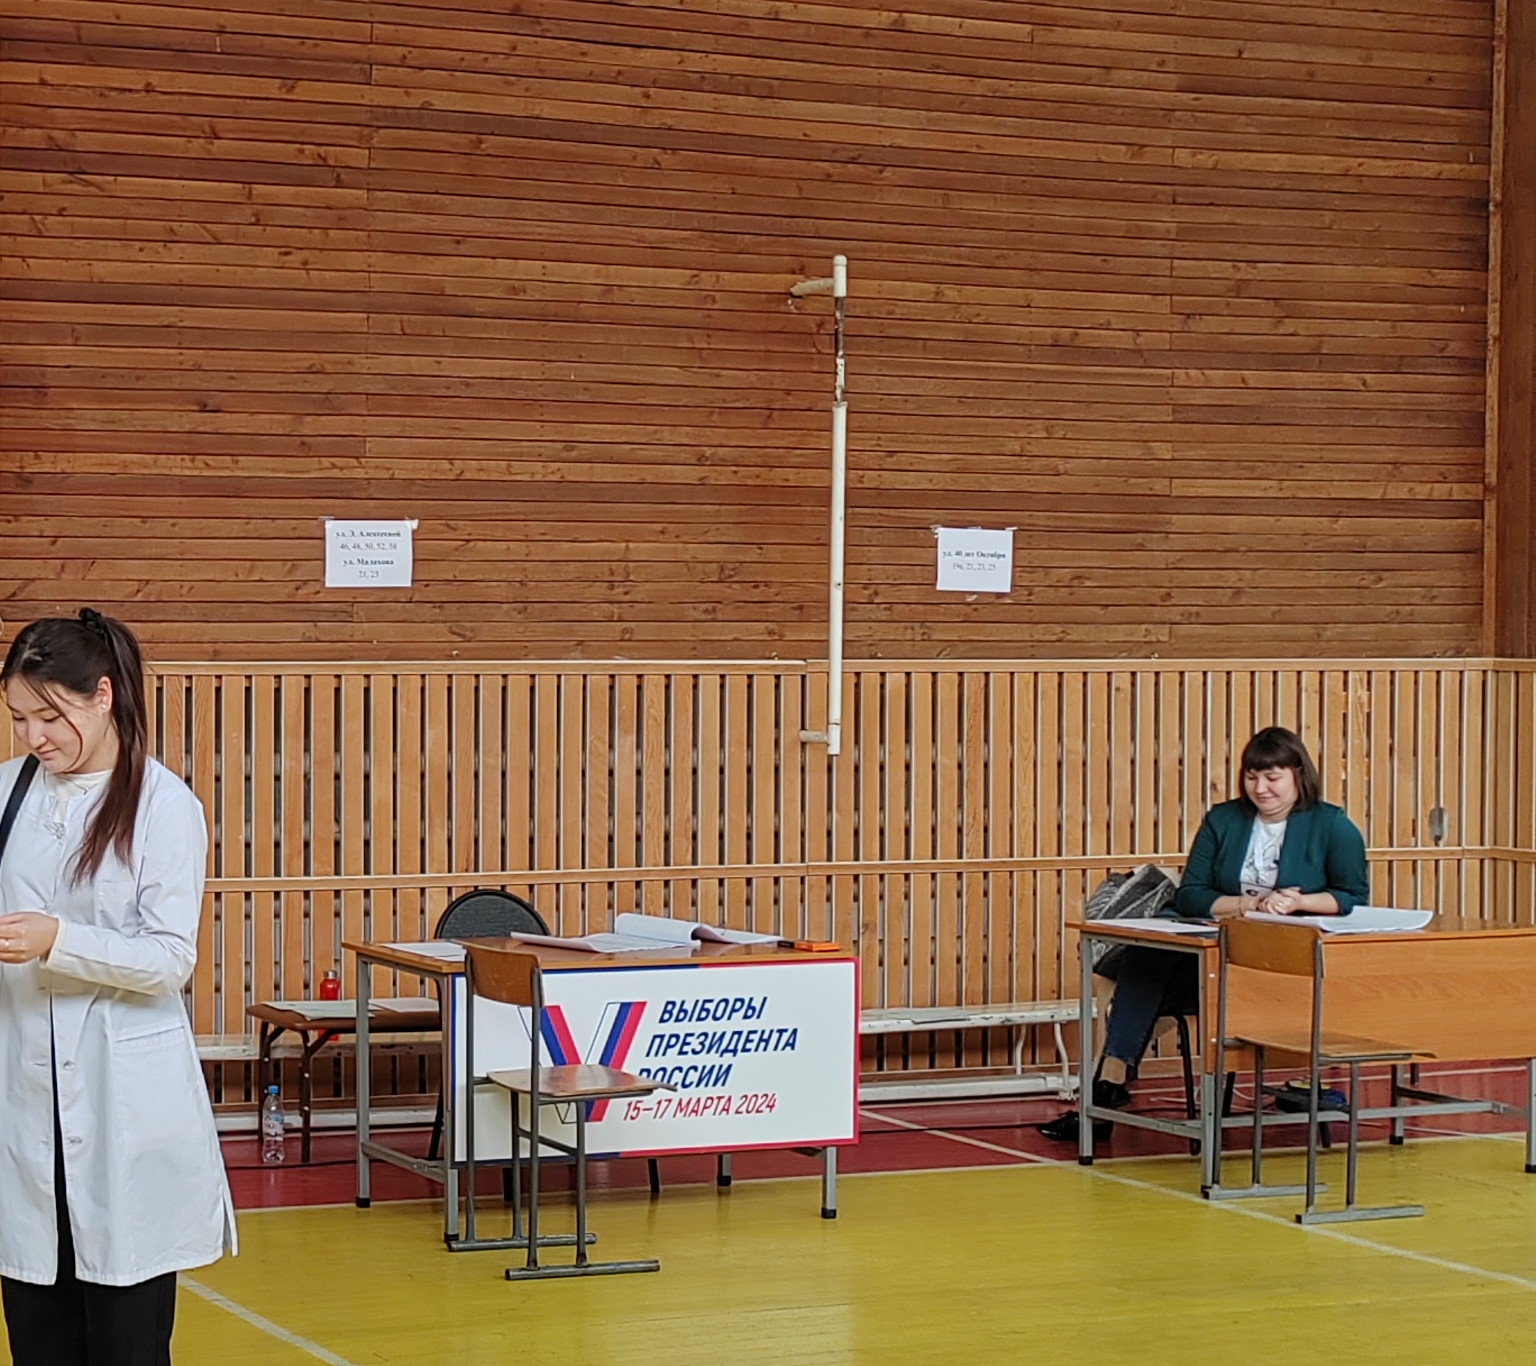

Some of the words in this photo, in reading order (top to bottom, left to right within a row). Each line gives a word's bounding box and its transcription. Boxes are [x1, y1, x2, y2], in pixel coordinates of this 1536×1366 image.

[658, 996, 768, 1024] ВЫБОРЫ
[645, 1028, 799, 1058] ПРЕЗИДЕНТА
[673, 1095, 732, 1118] МАРТА
[734, 1093, 777, 1115] 2024
